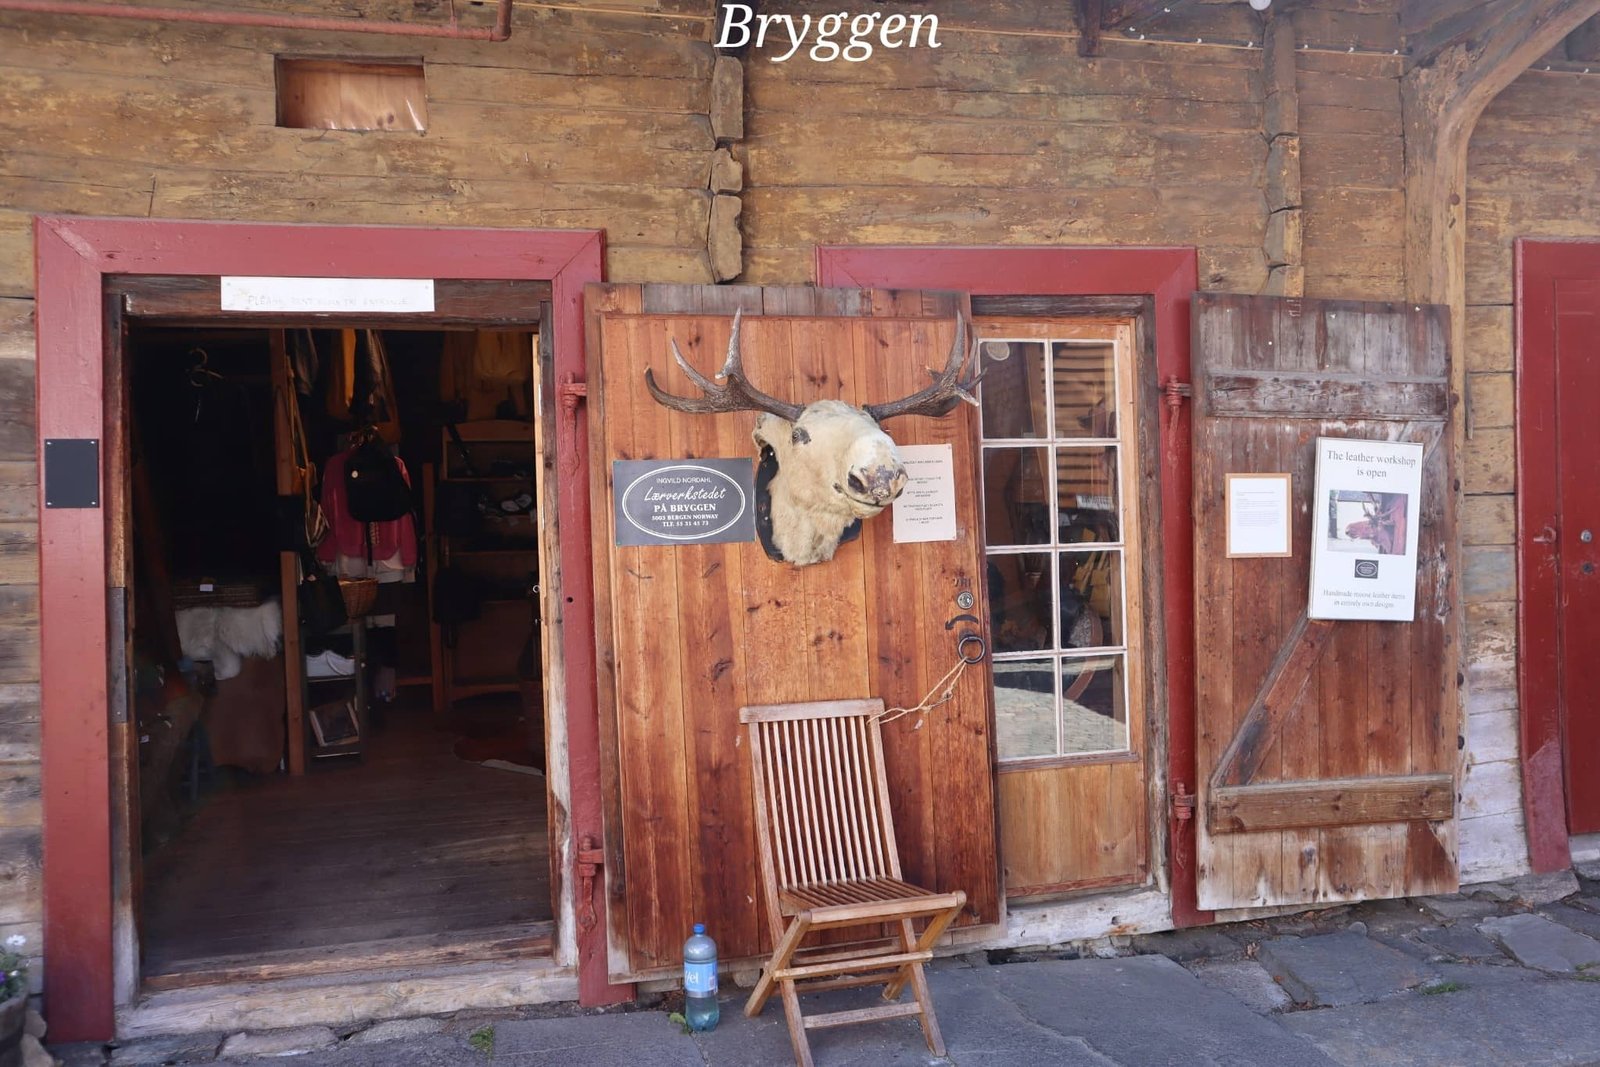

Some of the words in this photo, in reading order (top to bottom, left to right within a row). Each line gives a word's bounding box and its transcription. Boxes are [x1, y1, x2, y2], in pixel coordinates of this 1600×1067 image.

[1328, 450, 1344, 460] The
[1345, 451, 1374, 463] leather
[1376, 456, 1416, 468] workshop
[1357, 466, 1365, 476] is
[1366, 469, 1387, 479] open
[644, 486, 726, 501] Lærverkstedet
[654, 503, 667, 513] PÅ
[670, 503, 716, 512] BRYGGEN
[1323, 589, 1352, 598] Handmade
